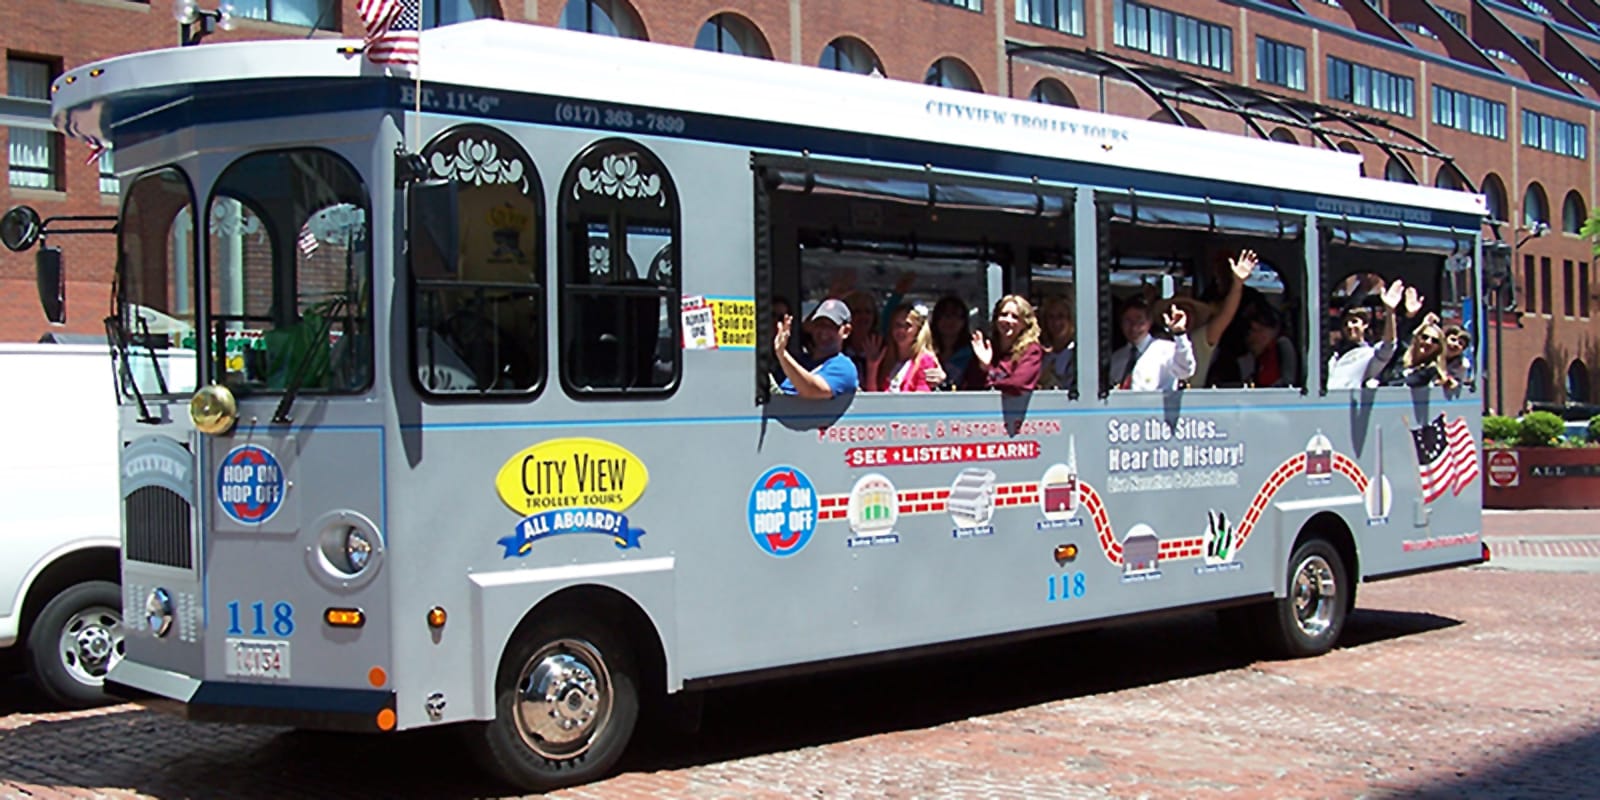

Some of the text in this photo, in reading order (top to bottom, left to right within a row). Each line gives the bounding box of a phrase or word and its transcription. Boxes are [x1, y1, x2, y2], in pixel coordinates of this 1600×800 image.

[555, 103, 600, 125] (617)
[604, 108, 633, 128] 363
[926, 99, 1129, 141] CITYVIEW TROLLEY TOURS
[718, 301, 754, 316] Tickets
[718, 316, 753, 330] Sold On
[817, 419, 1062, 443] FREEDOM TRAIL & HISTORIC BOSTON
[1108, 419, 1141, 443] See
[1145, 419, 1172, 441] the
[852, 442, 1035, 465] SEE LISTEN LEARN!
[1109, 443, 1245, 471] Hear the History!
[224, 465, 278, 483] HOP ON
[521, 453, 627, 495] CITY VIEW
[1532, 466, 1566, 476] ALL
[222, 485, 280, 503] HOP OFF
[526, 493, 623, 508] TROLLEY TOURS
[755, 487, 811, 511] HOP ON
[523, 511, 623, 539] ALL ABOARD!
[754, 510, 813, 534] HOP OFF
[1047, 571, 1086, 602] 118
[226, 599, 295, 637] 118
